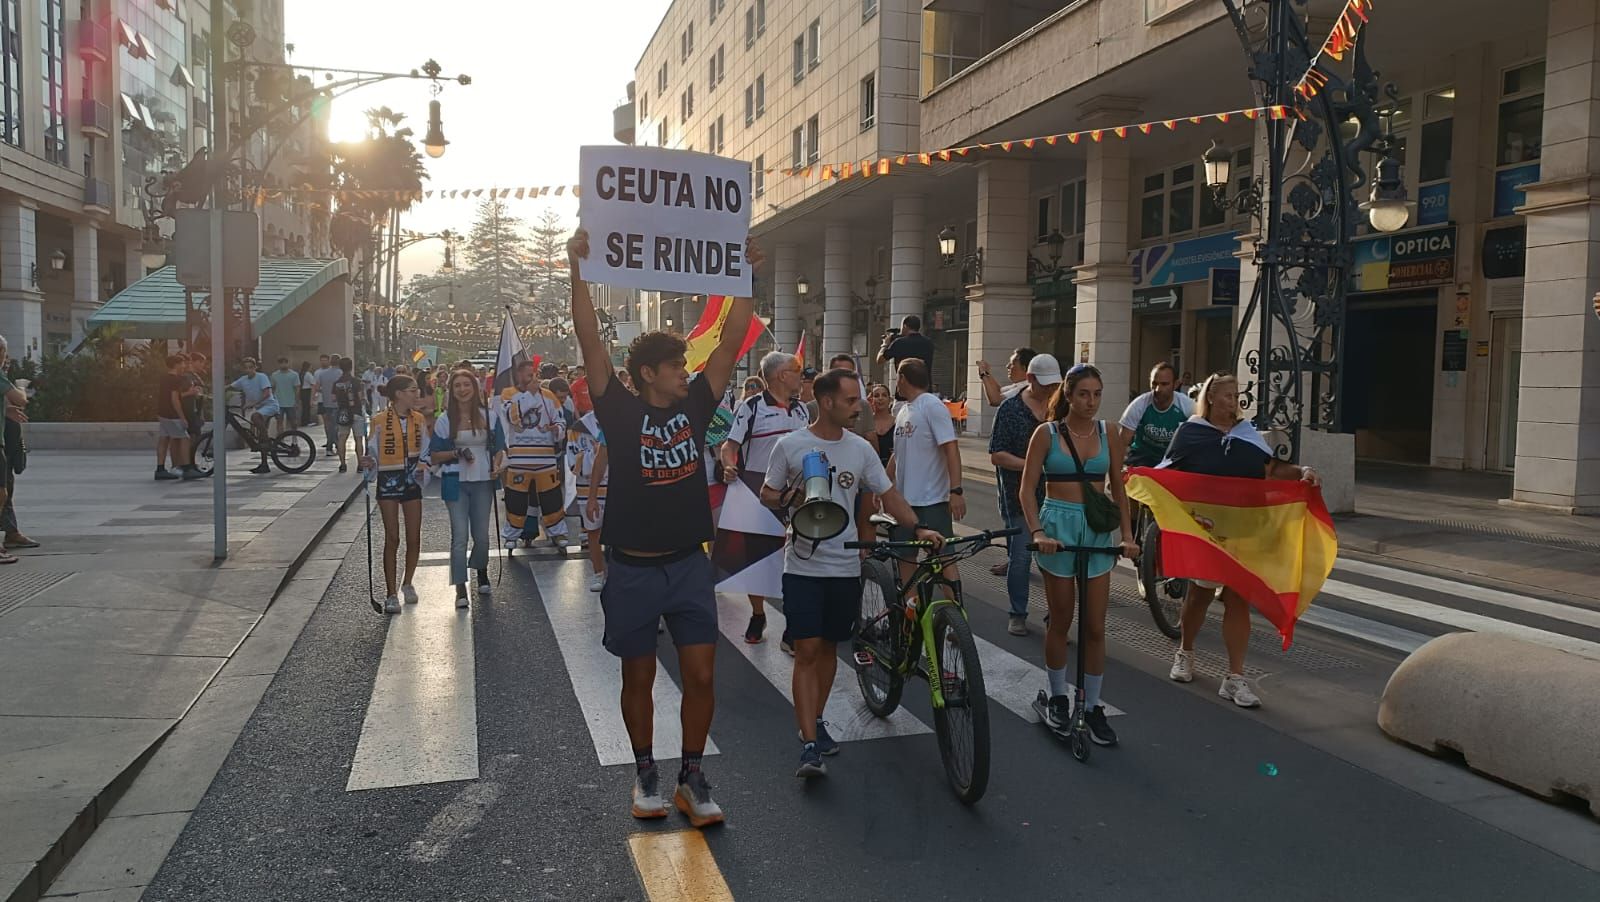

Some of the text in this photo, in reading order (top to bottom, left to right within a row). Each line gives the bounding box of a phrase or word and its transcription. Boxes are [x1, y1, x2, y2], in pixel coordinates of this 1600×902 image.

[596, 165, 742, 213] CEUTA NO
[605, 231, 742, 277] SE RINDE
[640, 437, 699, 468] CEUTA
